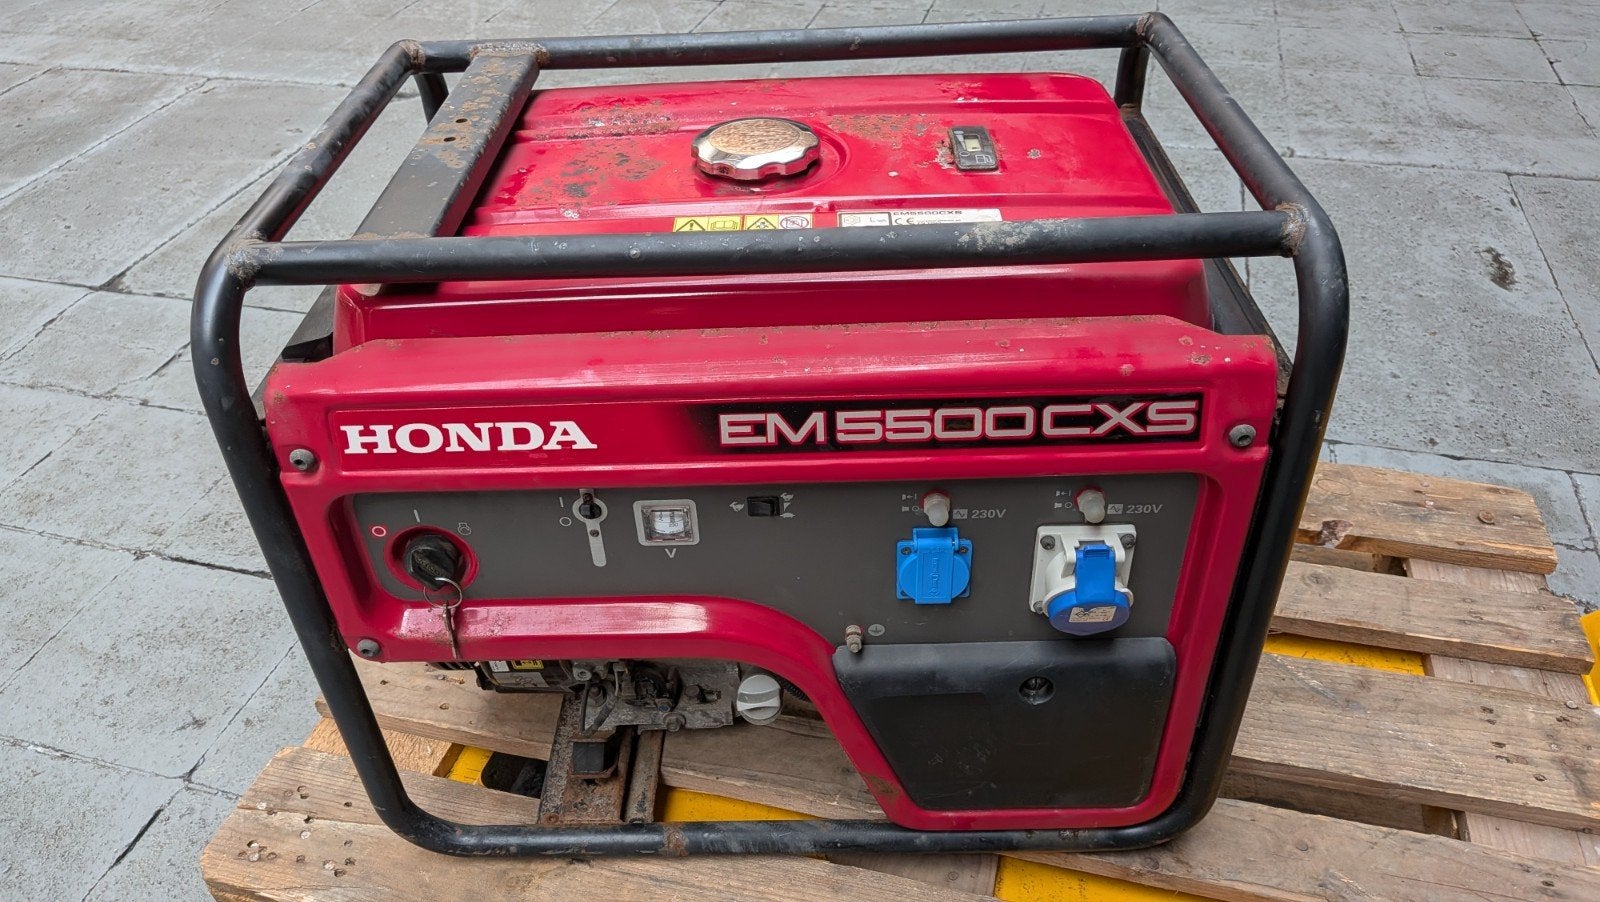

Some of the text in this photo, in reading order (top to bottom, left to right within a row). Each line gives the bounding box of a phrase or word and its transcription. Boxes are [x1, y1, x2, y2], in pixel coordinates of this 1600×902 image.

[339, 420, 598, 454] HONDA
[971, 508, 1007, 519] 230V
[1126, 503, 1163, 514] 230V
[664, 547, 677, 559] V
